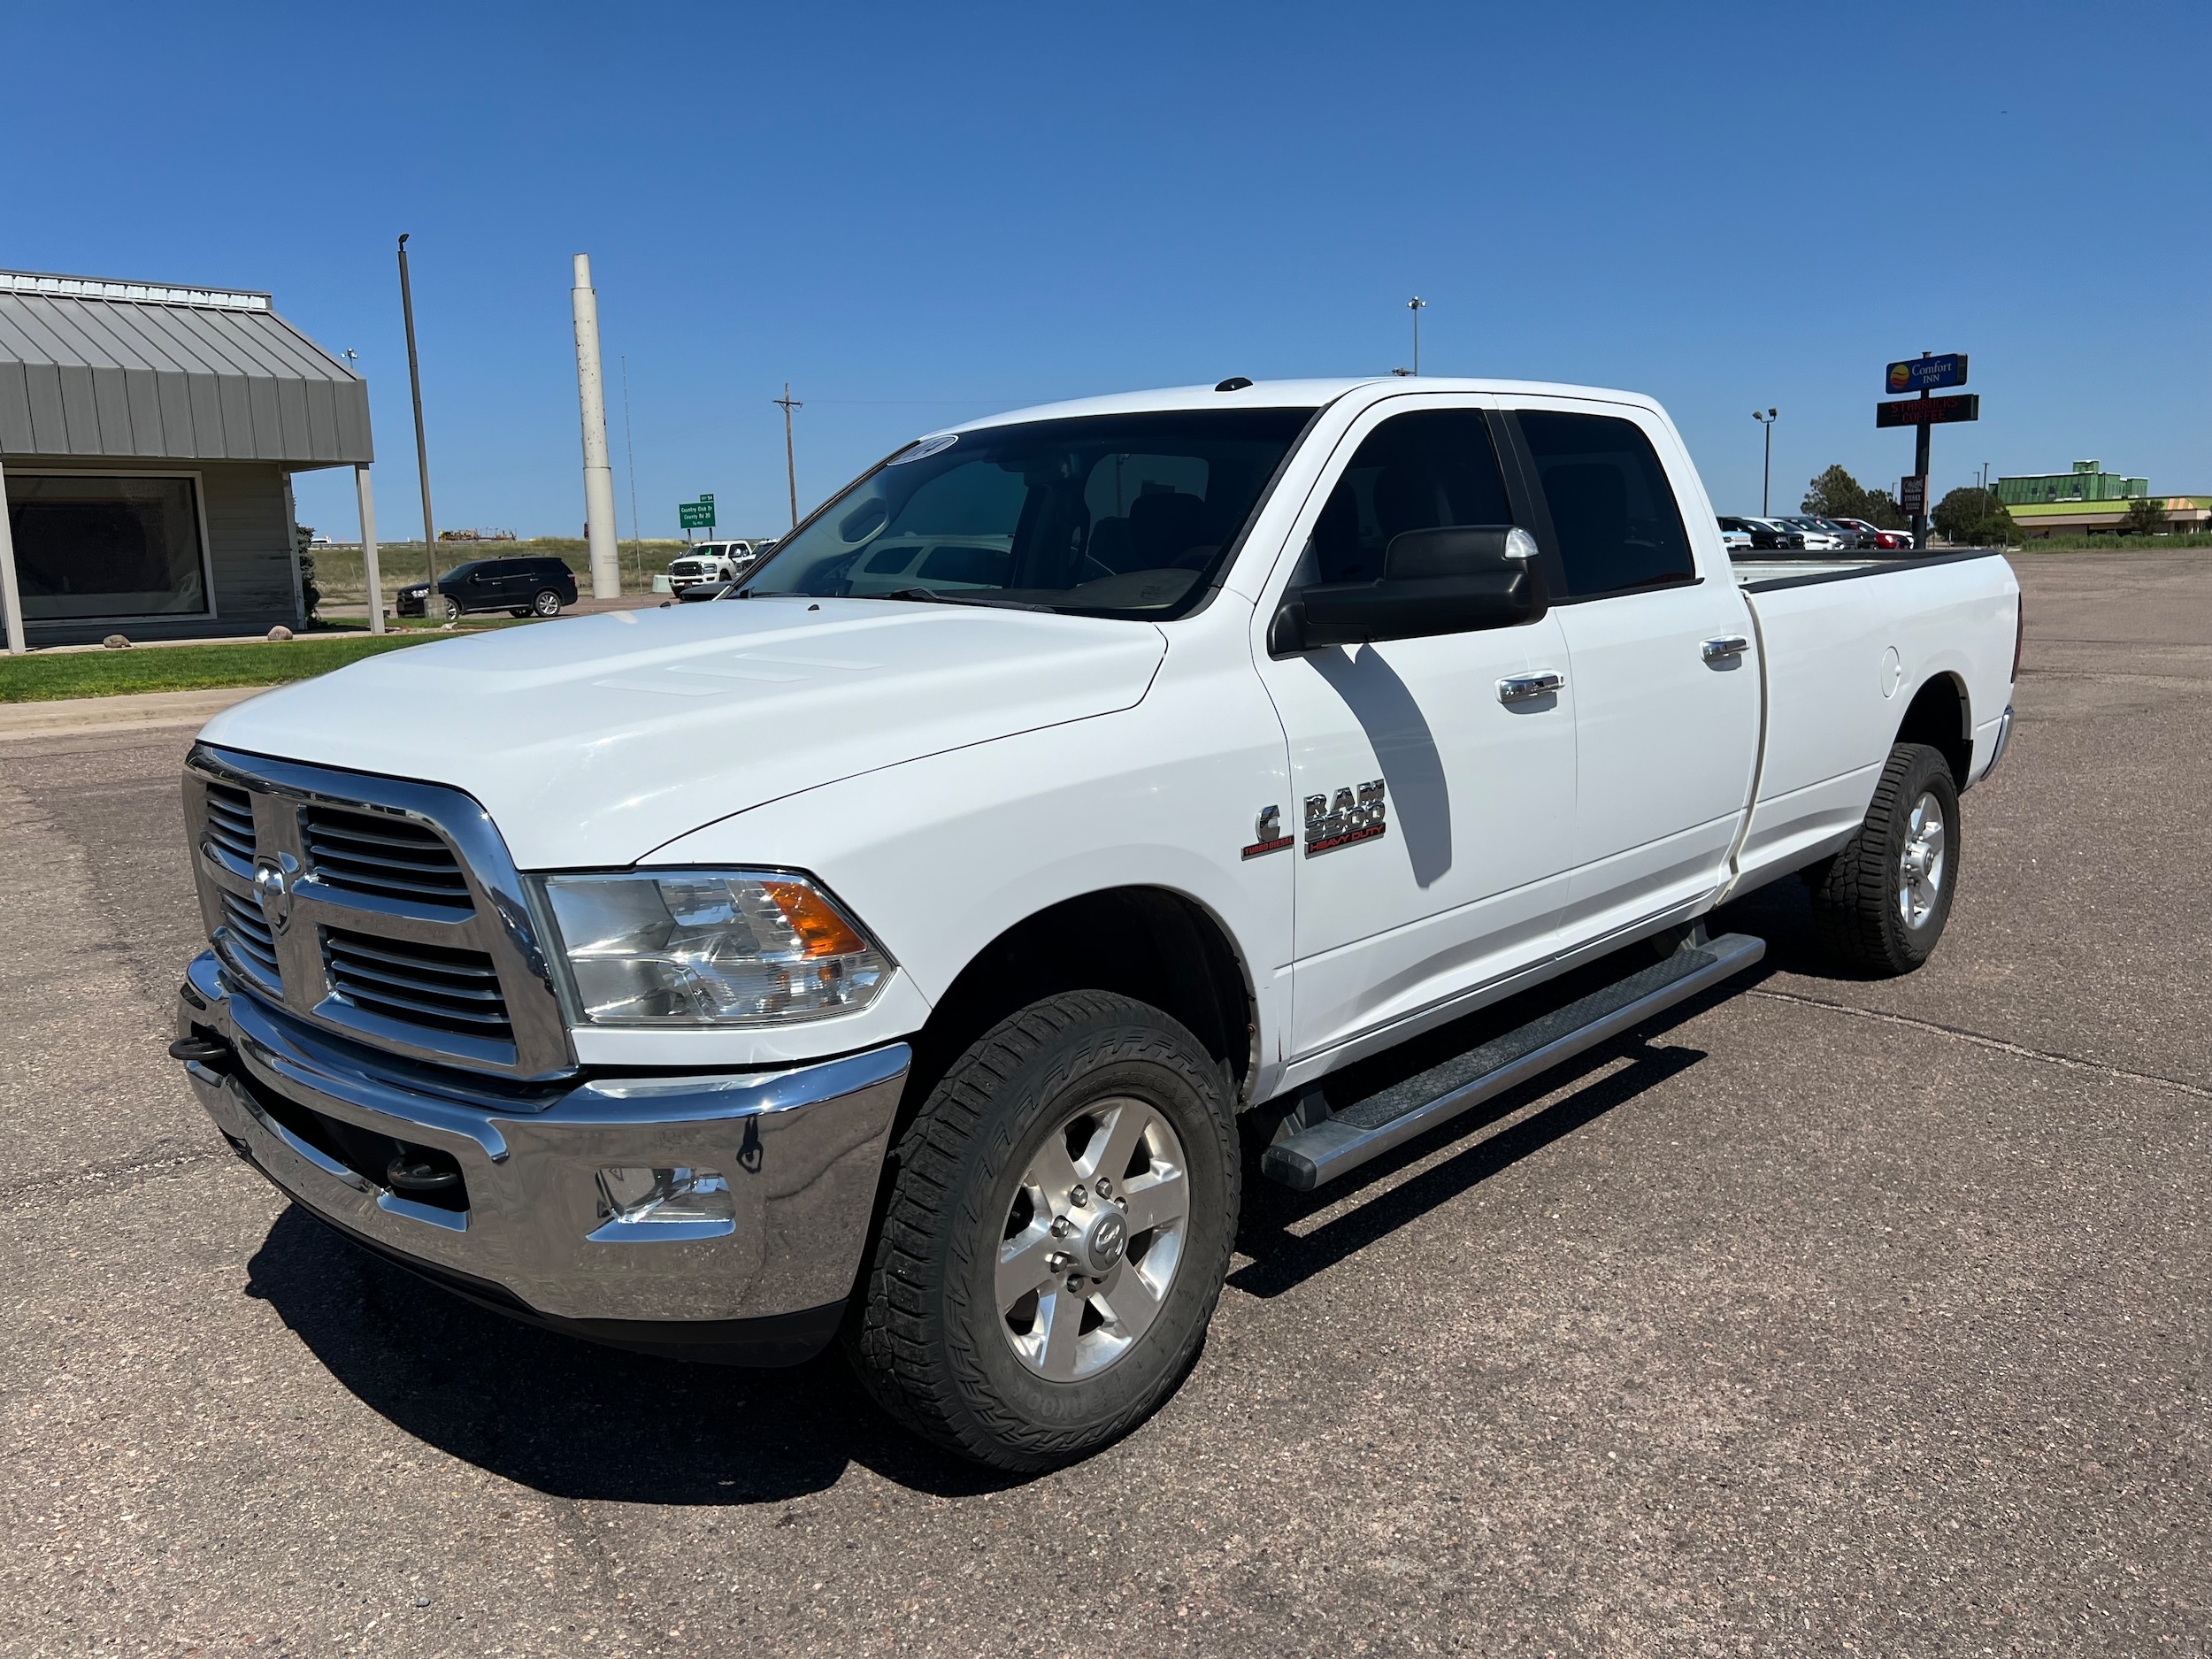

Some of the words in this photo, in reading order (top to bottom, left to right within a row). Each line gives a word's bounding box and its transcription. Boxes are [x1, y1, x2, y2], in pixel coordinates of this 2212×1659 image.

[1912, 361, 1952, 376] Comfort
[1923, 374, 1940, 384] INN
[1891, 397, 1958, 413] STARBUCKS
[1901, 410, 1945, 424] COFFEE
[1303, 779, 1385, 818] RAM
[1245, 842, 1269, 855] TURBO
[1269, 837, 1294, 849] DIESEL
[1310, 833, 1350, 852] HEAVY
[1351, 826, 1384, 841] DUTY
